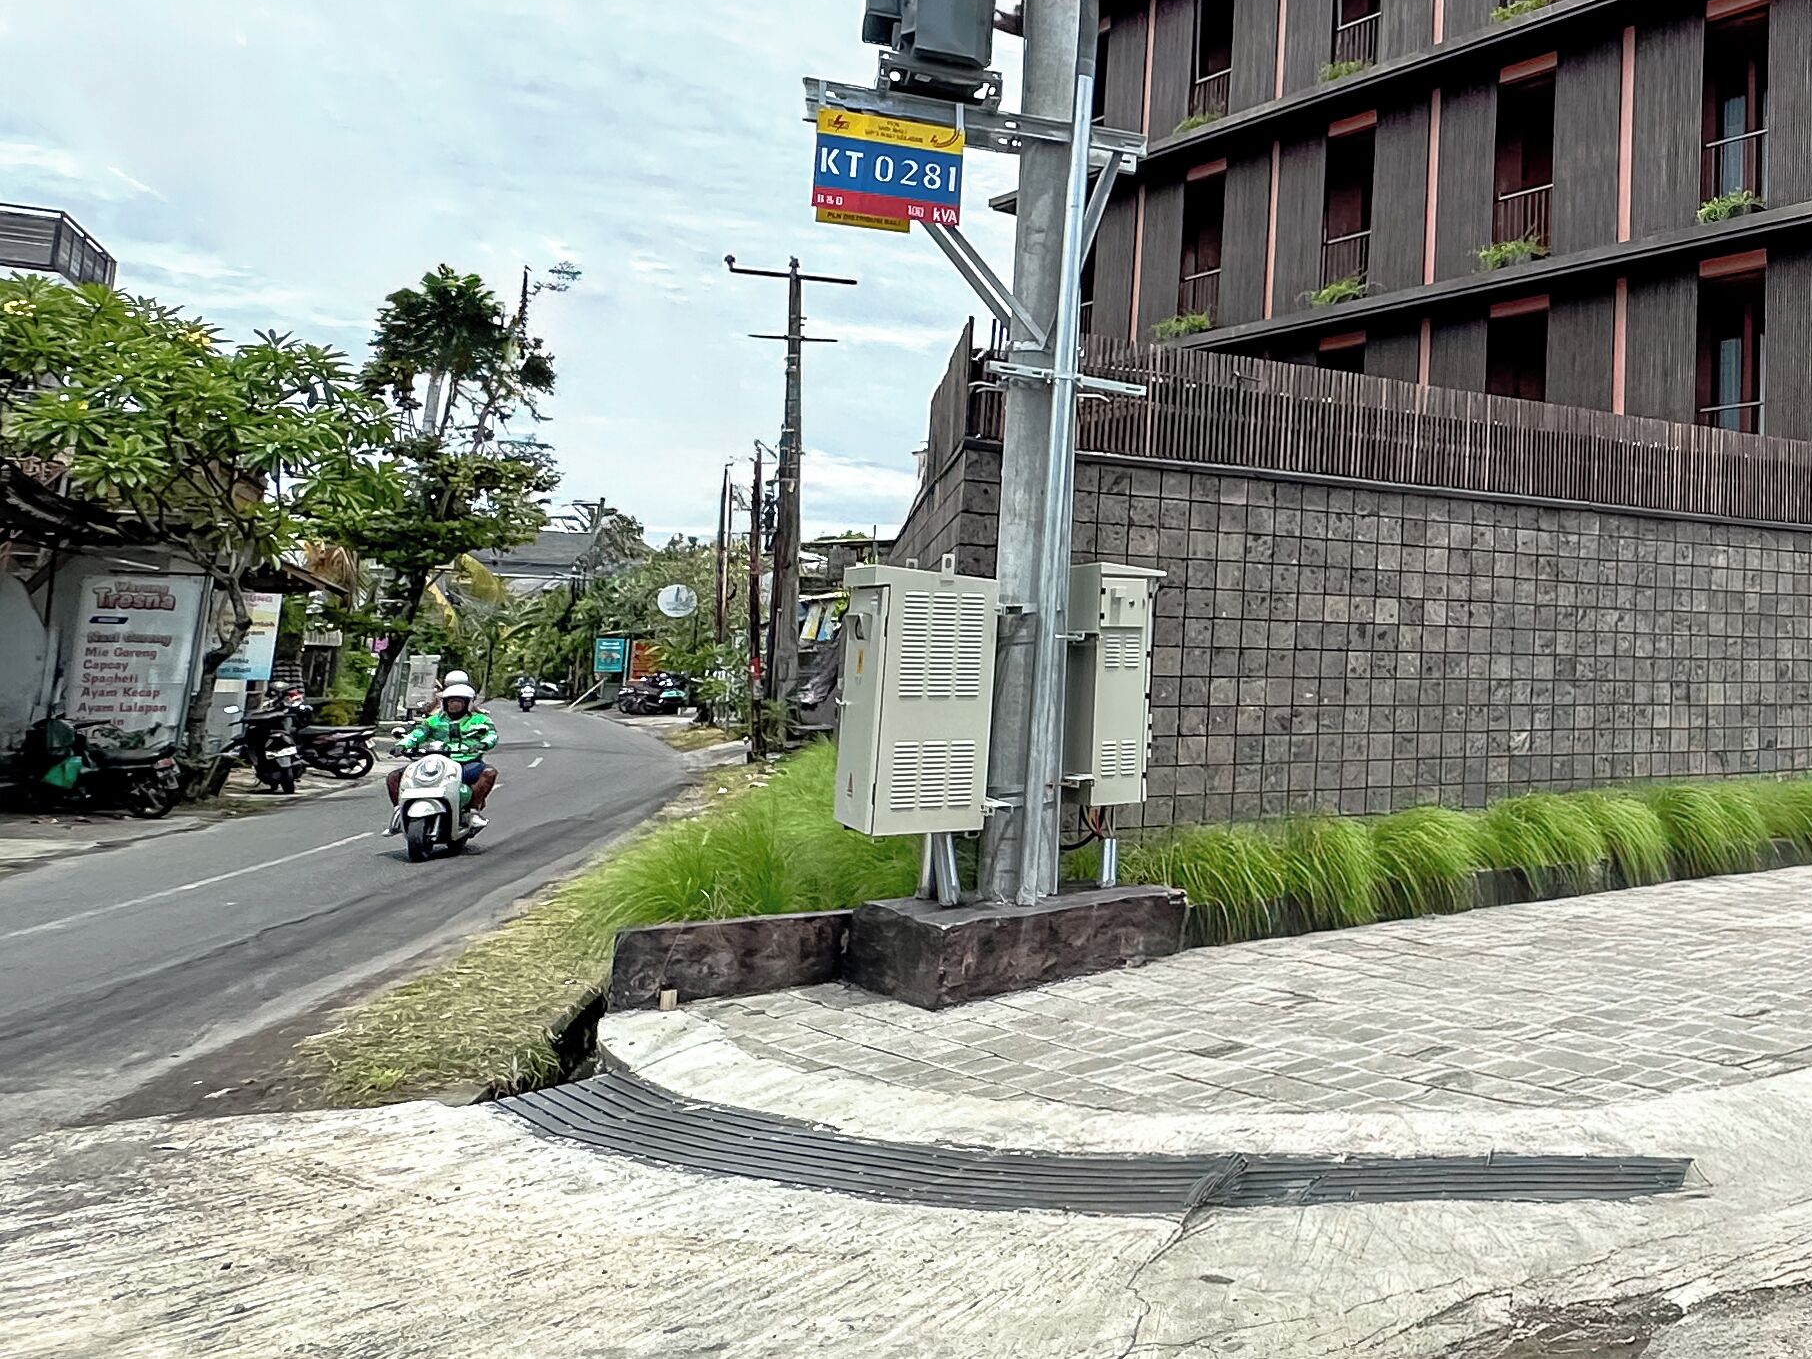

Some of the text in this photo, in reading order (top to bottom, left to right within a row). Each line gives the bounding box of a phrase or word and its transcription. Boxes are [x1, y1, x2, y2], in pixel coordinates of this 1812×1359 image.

[820, 147, 957, 192] KT 0281
[932, 207, 958, 223] kVA
[92, 587, 177, 611] Tresna
[84, 647, 157, 660] Mie Goreng
[83, 660, 129, 671] Capcay
[81, 687, 160, 699] Ayam Kecap
[77, 702, 167, 714] Ayam Lalapan
